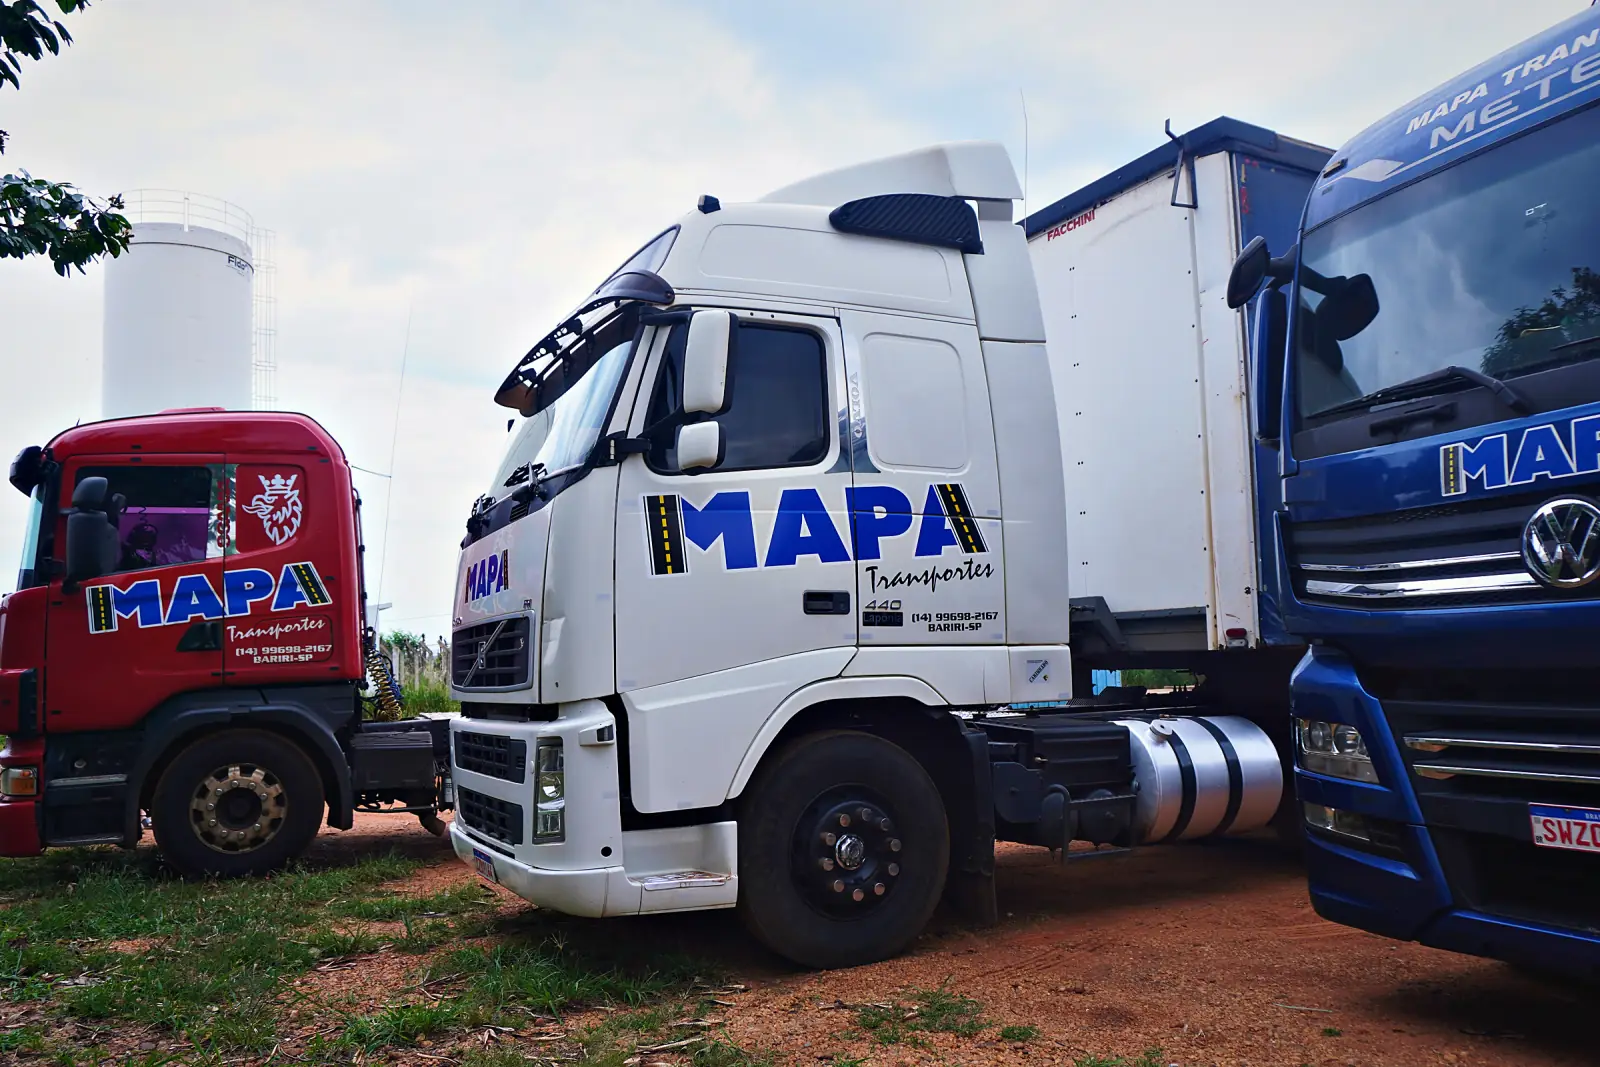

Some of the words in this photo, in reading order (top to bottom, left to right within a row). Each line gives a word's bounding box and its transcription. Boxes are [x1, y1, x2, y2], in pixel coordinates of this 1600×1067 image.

[1405, 82, 1488, 134] MAPA
[1501, 28, 1600, 86] TRAN
[1047, 209, 1095, 241] FACCHINI
[643, 483, 990, 575] MAPA
[465, 549, 509, 604] MAPA
[866, 557, 995, 593] Transportes
[86, 561, 332, 634] MAPA
[865, 599, 902, 611] 440
[226, 616, 326, 642] Transportes
[911, 613, 932, 623] (14)
[935, 611, 999, 622] 99698-2167
[928, 623, 982, 633] BARIRI-SP
[235, 647, 258, 657] (14)
[261, 644, 333, 655] 99698-2167
[253, 653, 313, 664] BARIRI-SP
[1584, 812, 1600, 820] BRA
